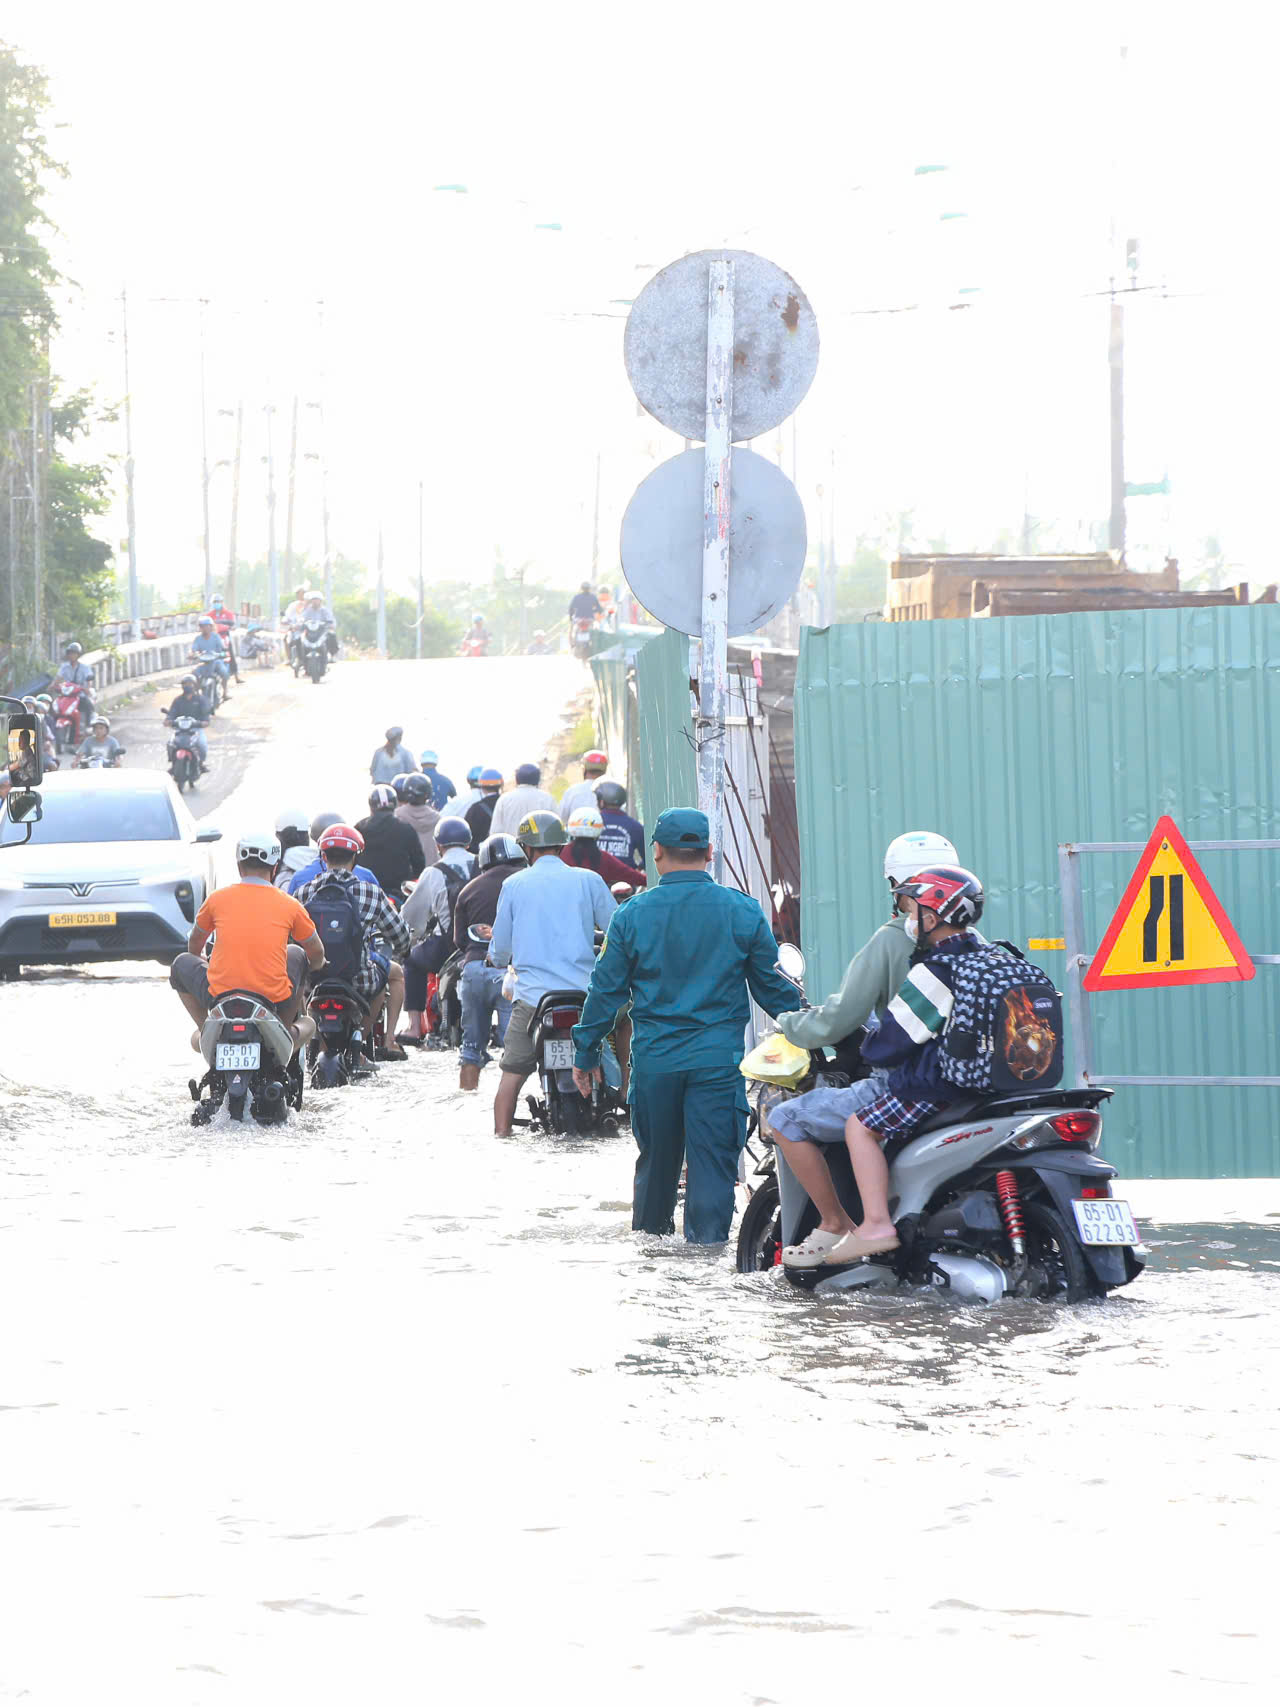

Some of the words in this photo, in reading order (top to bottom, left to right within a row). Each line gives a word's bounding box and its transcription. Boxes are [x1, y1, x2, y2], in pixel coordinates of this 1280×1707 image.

[219, 1056, 257, 1068] 313.67
[1082, 1203, 1124, 1222] 65-D1
[1082, 1223, 1136, 1242] 622.93
